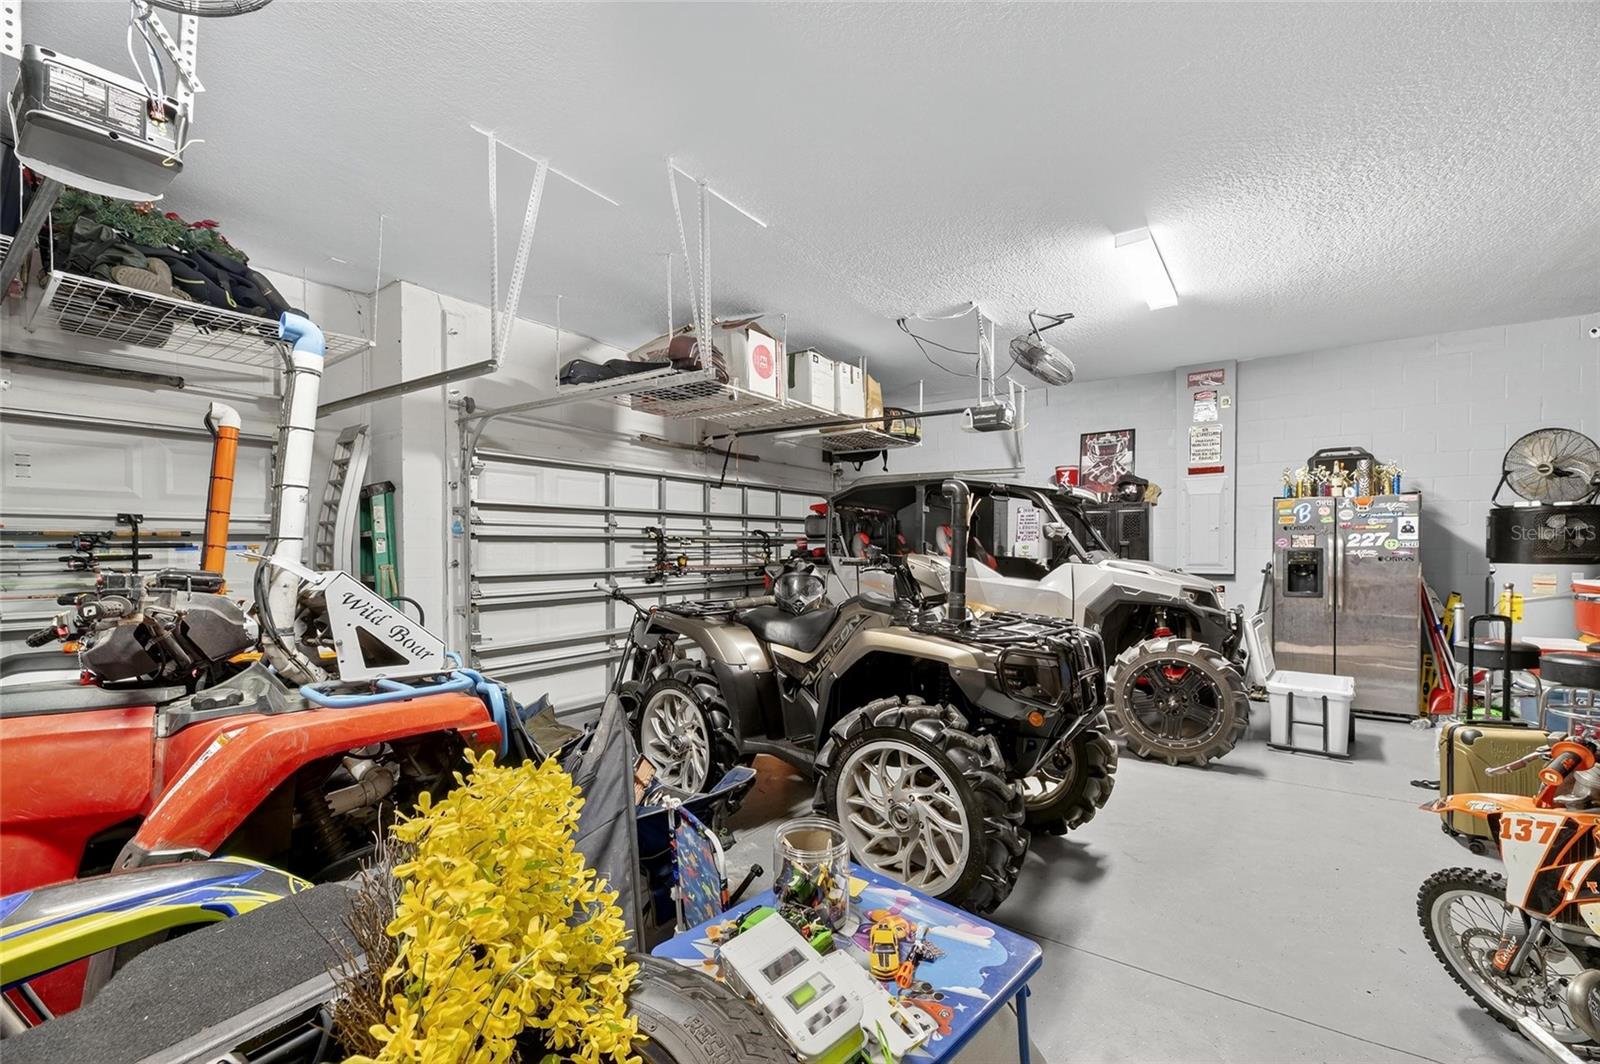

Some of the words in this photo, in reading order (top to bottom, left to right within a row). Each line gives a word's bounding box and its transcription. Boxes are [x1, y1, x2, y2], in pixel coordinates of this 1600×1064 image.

[1293, 503, 1311, 523] B
[1346, 532, 1390, 547] 227
[342, 592, 392, 626] Wild
[388, 625, 434, 660] Boar
[801, 614, 860, 686] RUBICON
[1499, 817, 1557, 845] 137
